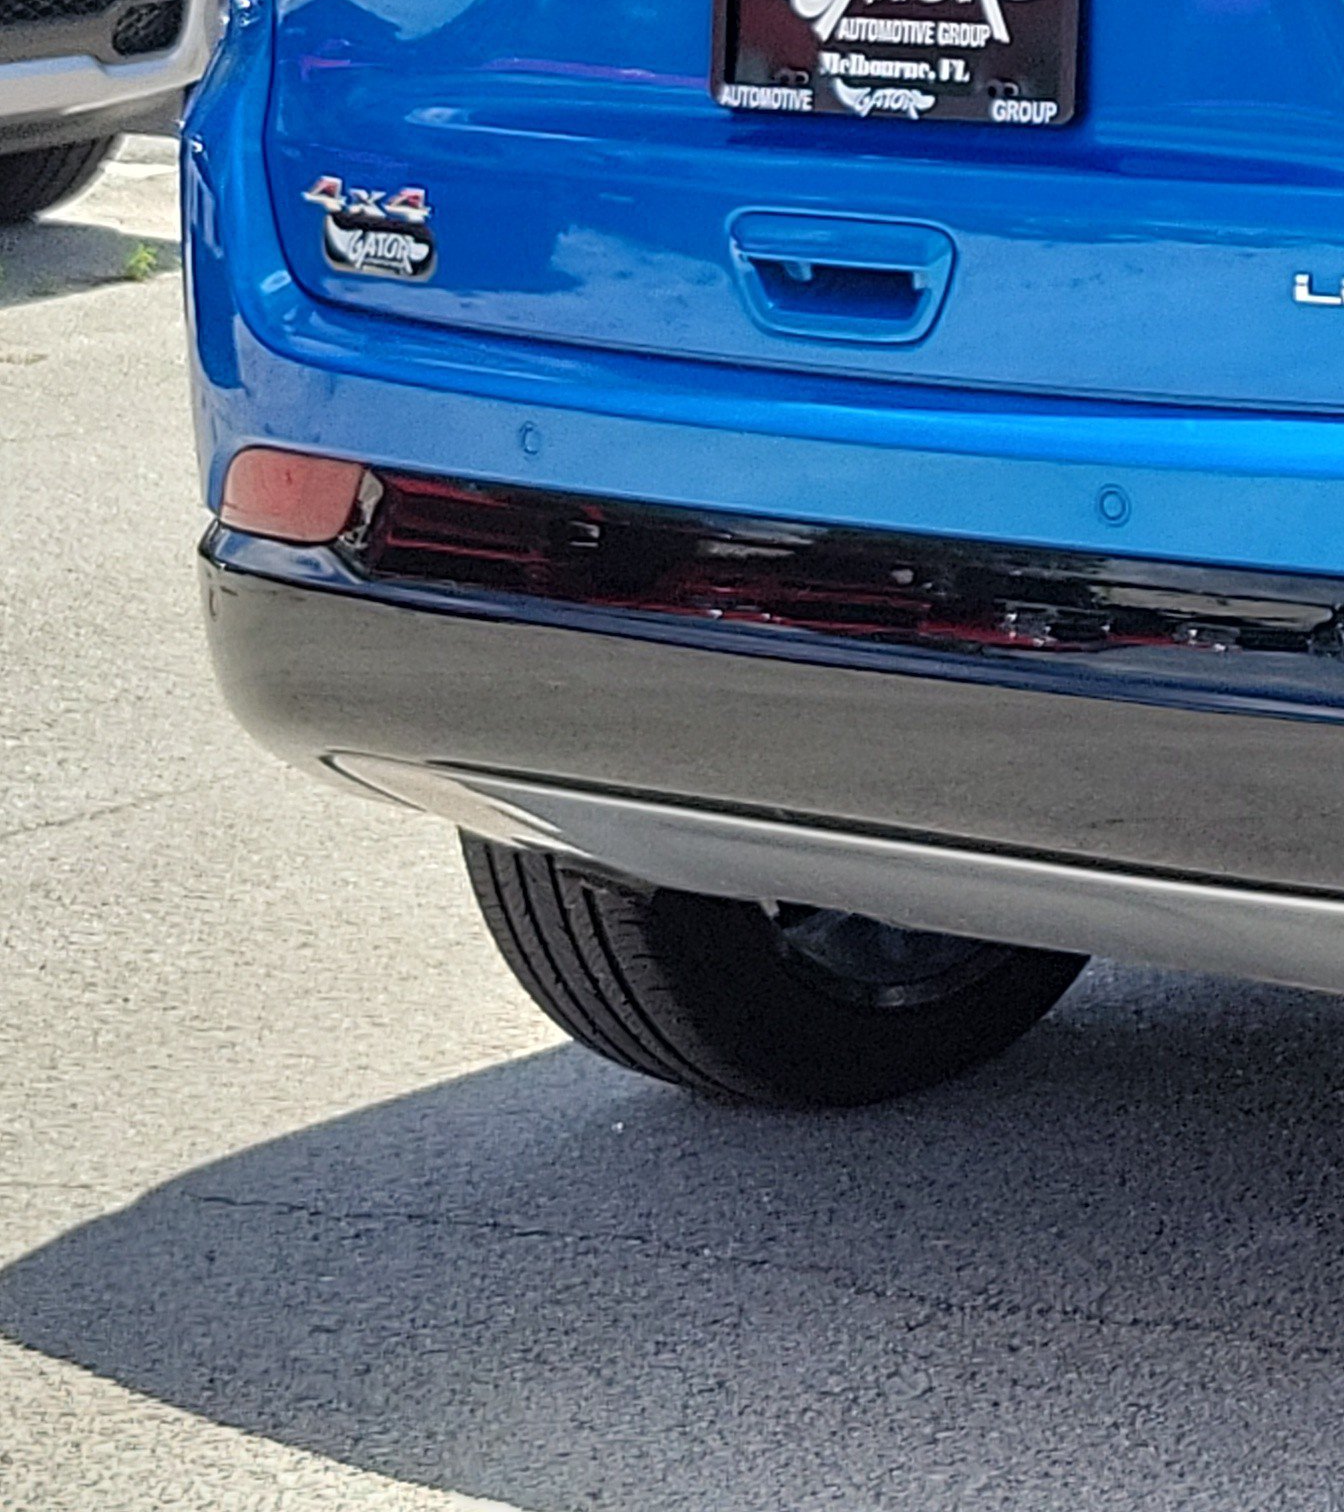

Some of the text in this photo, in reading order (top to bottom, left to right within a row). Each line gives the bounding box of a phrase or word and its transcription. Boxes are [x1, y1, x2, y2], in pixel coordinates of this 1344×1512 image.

[837, 16, 993, 47] AUTOMOTIVE GROUP
[939, 57, 971, 83] FL
[719, 85, 1058, 125] AUTOMOTIVE GATOR GROUP
[347, 229, 413, 274] GATOR
